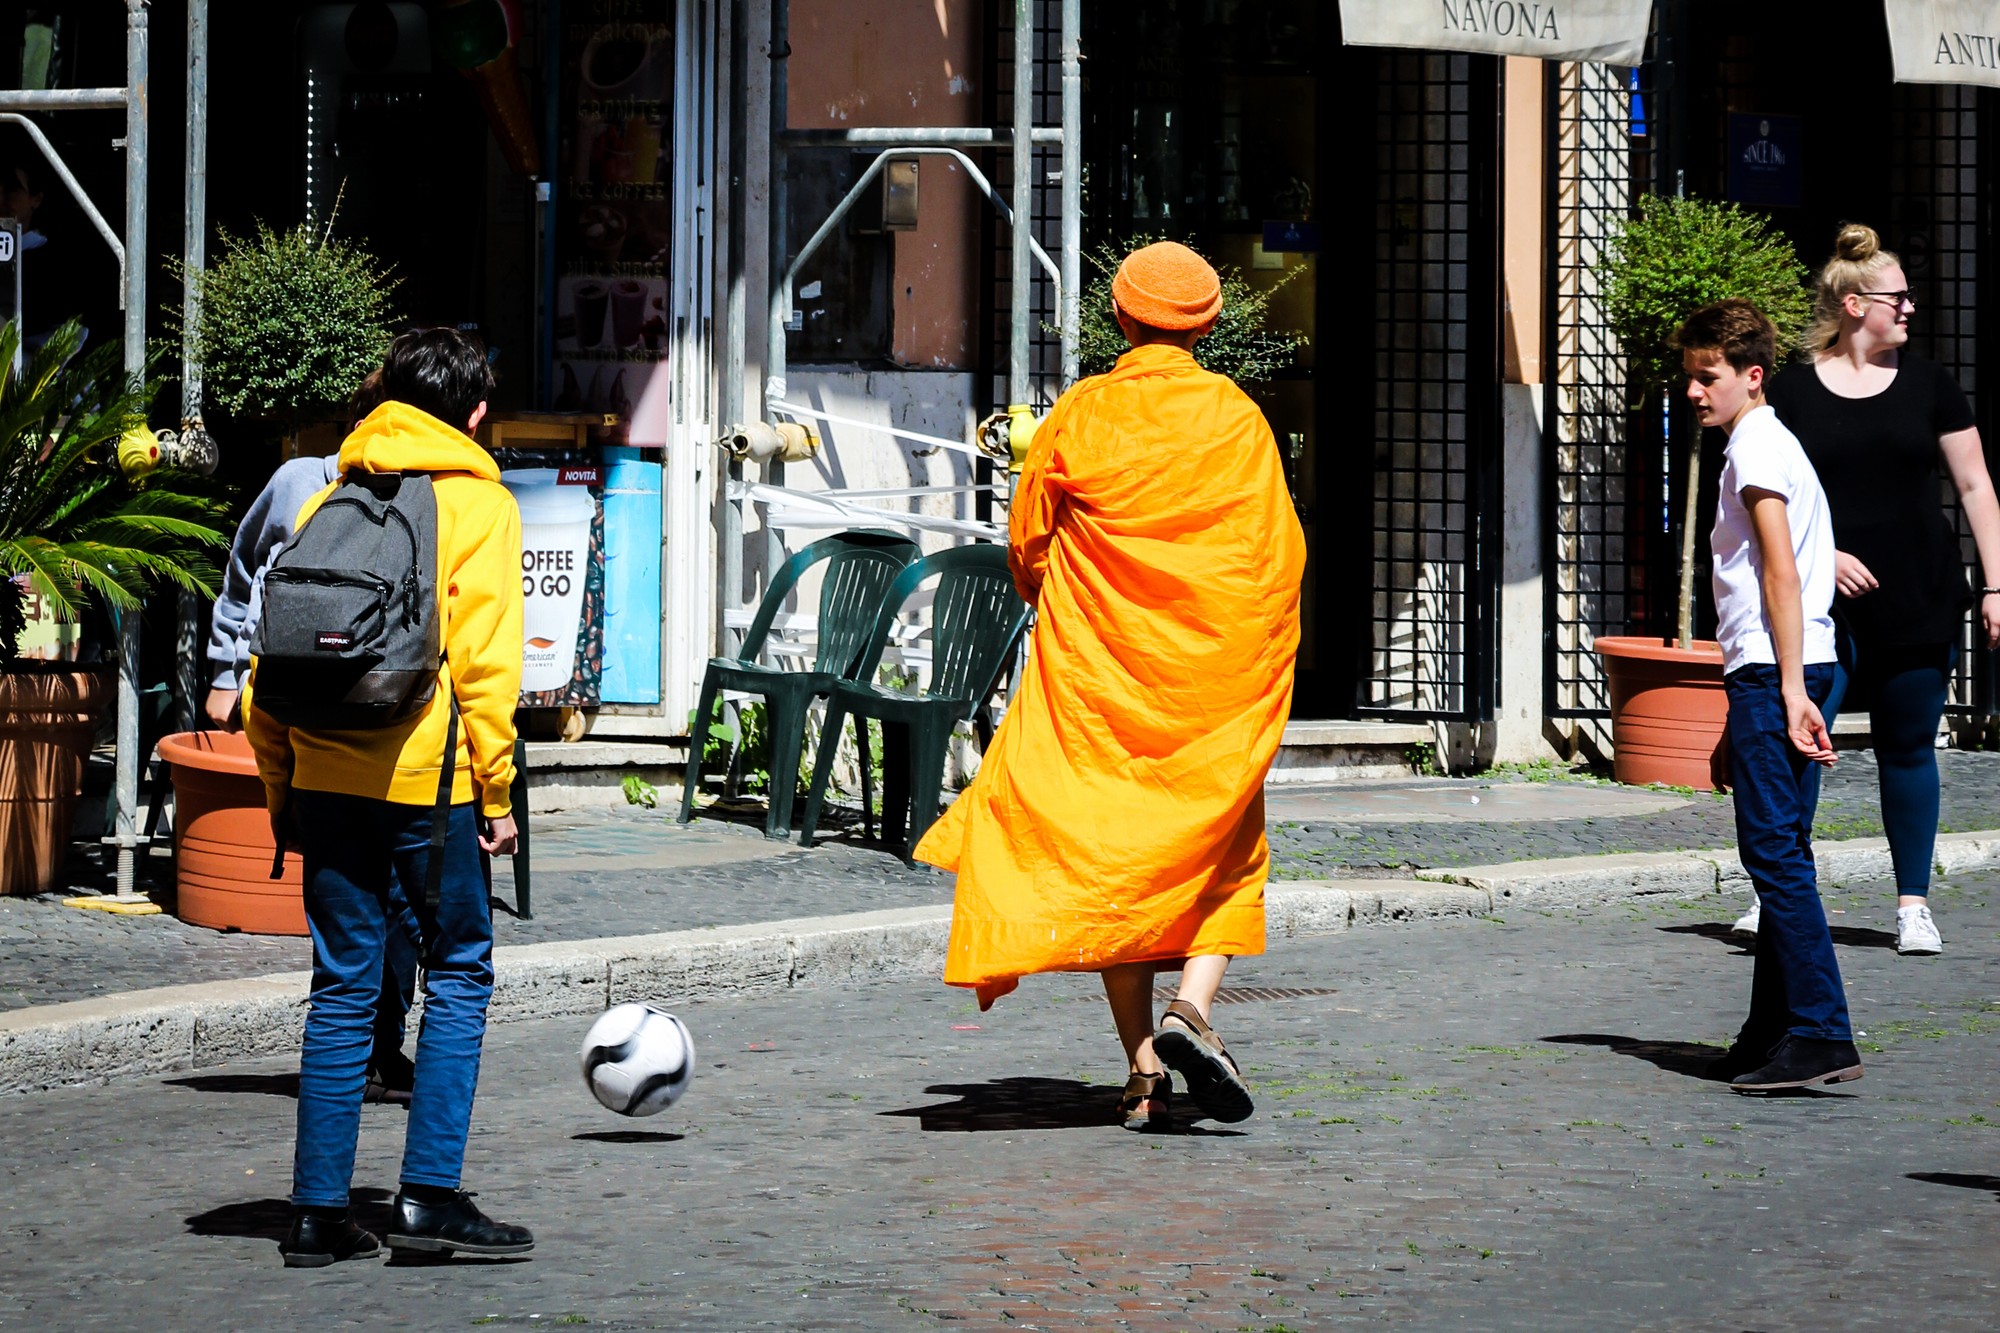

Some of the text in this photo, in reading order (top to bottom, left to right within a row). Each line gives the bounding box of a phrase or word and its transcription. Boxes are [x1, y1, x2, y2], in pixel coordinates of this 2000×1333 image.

[1442, 0, 1561, 40] NAVONA
[1934, 32, 2000, 69] ANTI
[1744, 140, 1768, 164] SINCE
[600, 180, 665, 201] COFFEE
[565, 468, 597, 482] NOVITÀ
[521, 550, 574, 572] OFFEE
[522, 575, 571, 597] O GO
[319, 637, 349, 646] EASTPAK
